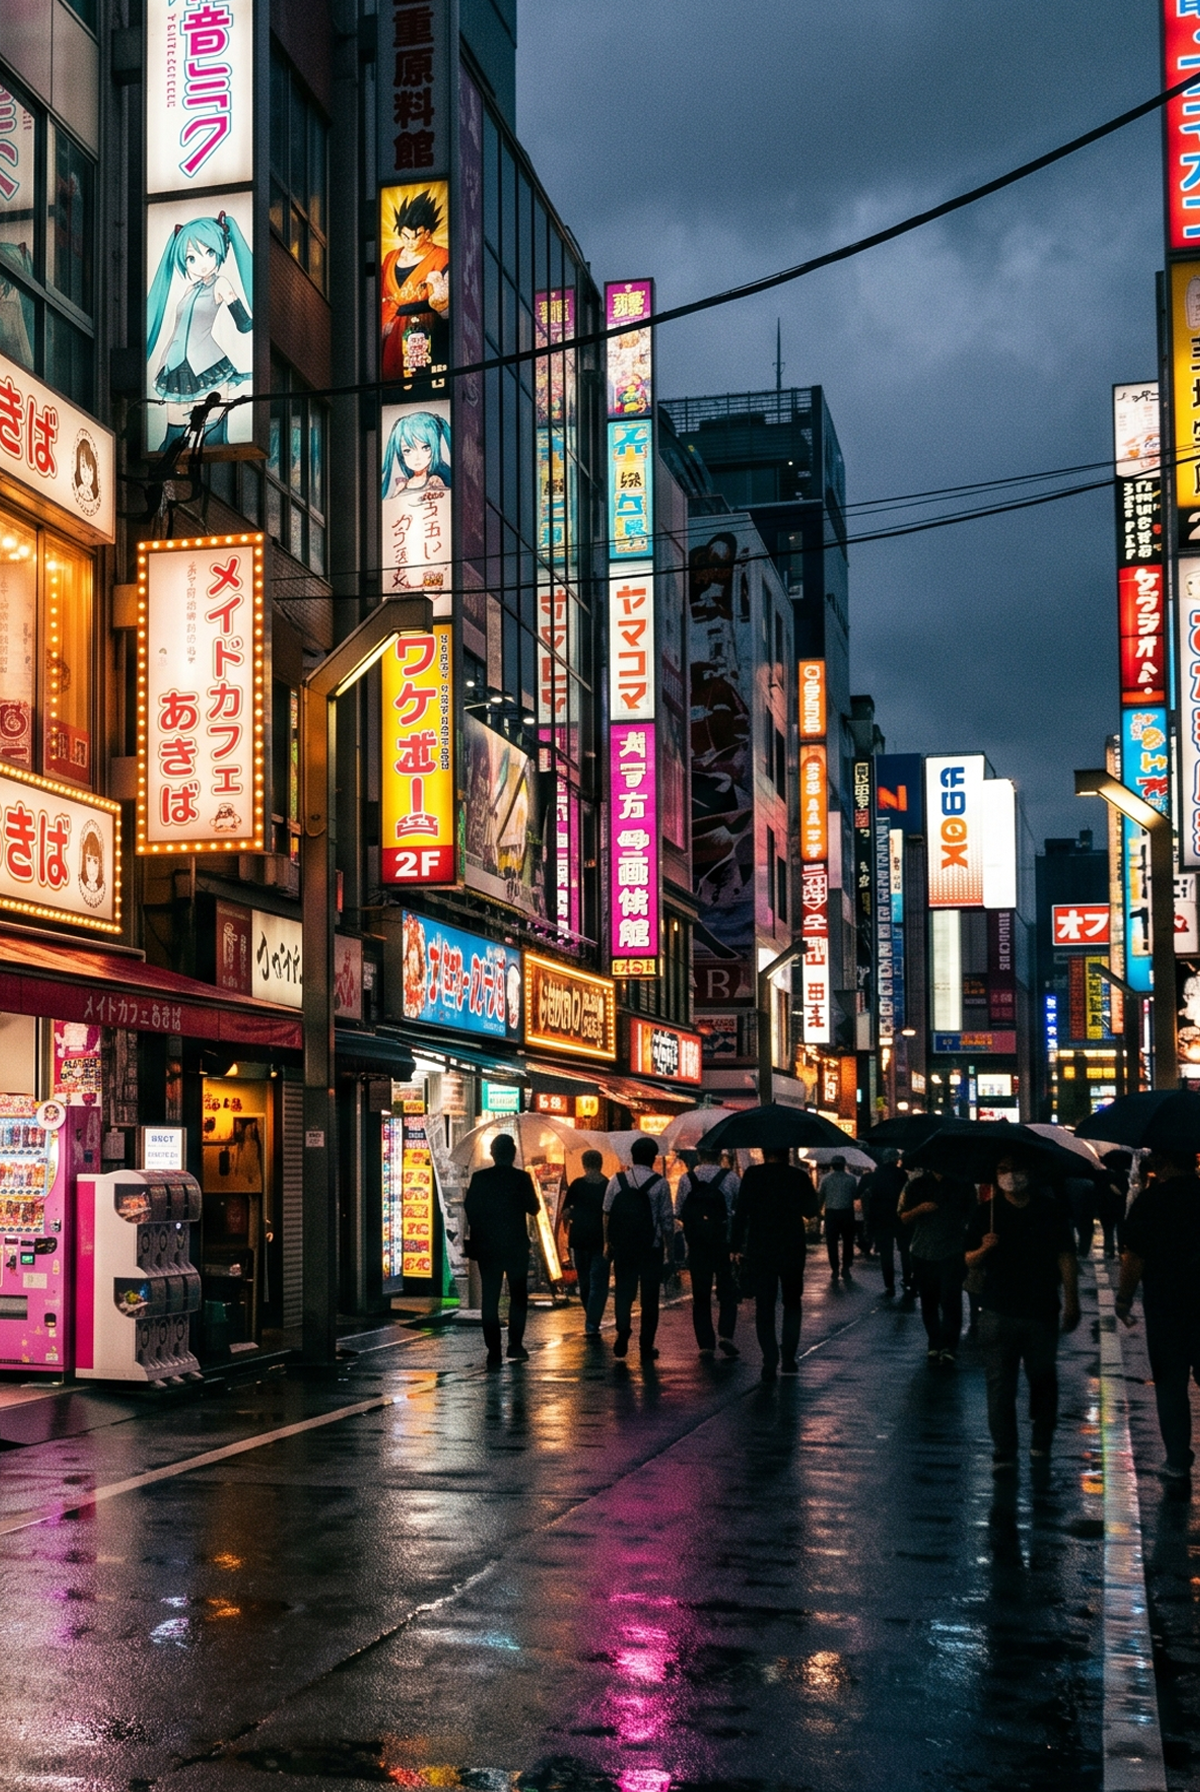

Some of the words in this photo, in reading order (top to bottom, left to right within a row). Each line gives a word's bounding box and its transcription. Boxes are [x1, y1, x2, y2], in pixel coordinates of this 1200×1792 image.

[169, 0, 234, 178] 音ミク
[206, 554, 244, 796] メイドカフェ
[157, 688, 202, 827] あきば
[394, 851, 441, 878] 2F
